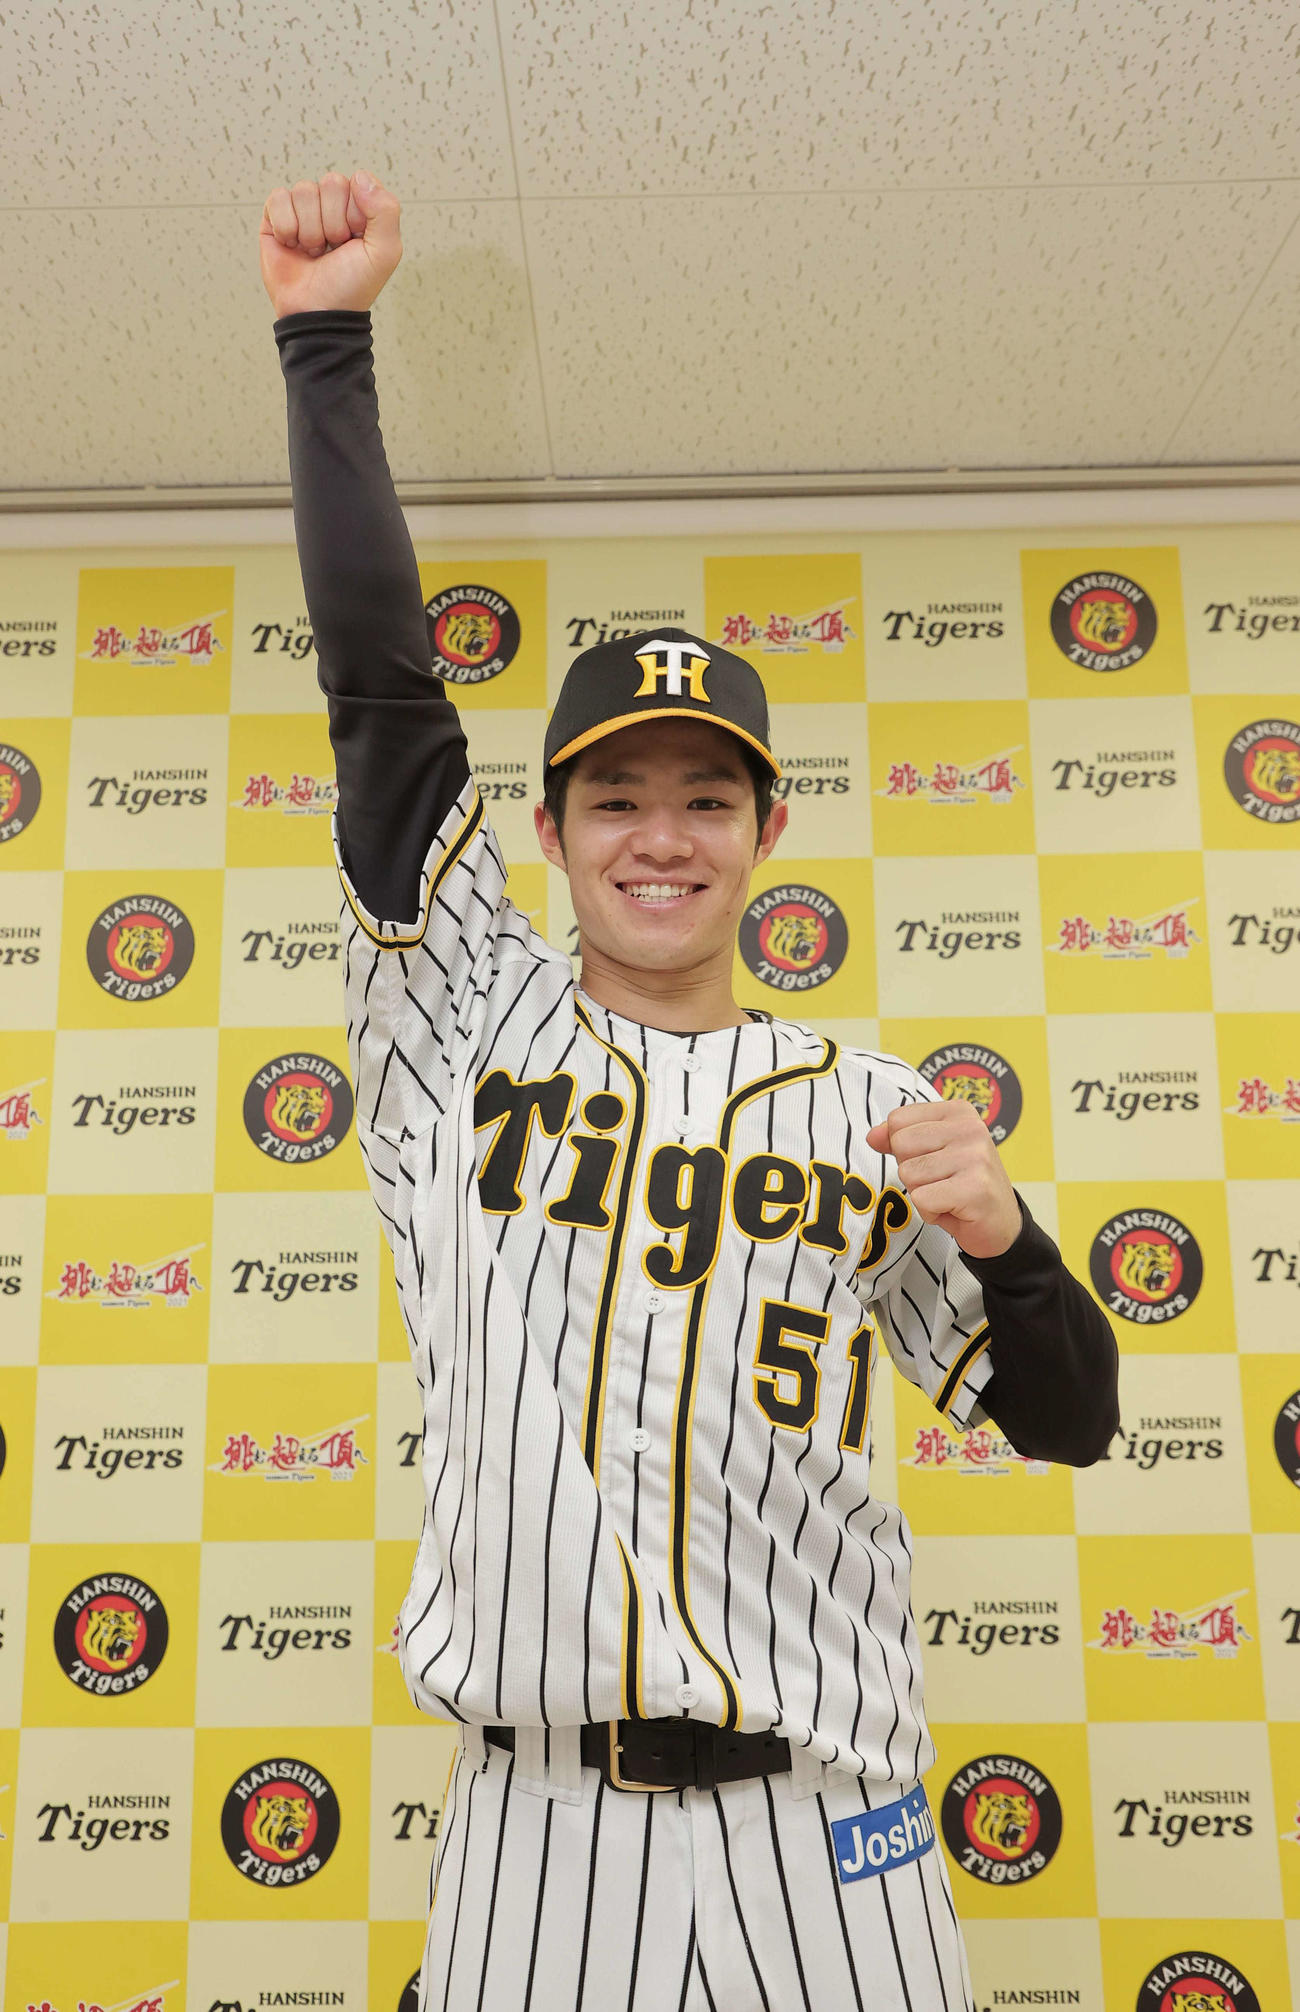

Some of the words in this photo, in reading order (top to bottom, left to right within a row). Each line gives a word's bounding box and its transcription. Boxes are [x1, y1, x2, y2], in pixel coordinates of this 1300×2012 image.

[426, 588, 509, 618] HANSHIN
[1061, 574, 1143, 606] HANSHIN
[611, 609, 685, 621] HANSHIN
[928, 602, 1003, 614] HANSHIN
[1204, 603, 1300, 640] Tiger
[0, 621, 57, 632] NSHIN
[252, 623, 314, 660] Tig
[883, 610, 1004, 647] Tigers
[0, 639, 57, 657] ers
[1069, 643, 1143, 671] Tigers
[432, 656, 504, 683] Tigers
[474, 763, 527, 775] NSHIN
[1097, 750, 1175, 762] HANSHIN
[133, 769, 208, 781] HANSHIN
[477, 782, 527, 800] ers
[773, 776, 850, 800] gers
[1052, 760, 1177, 798] Tigers
[87, 776, 208, 814] Tigers
[1243, 793, 1300, 822] Tige
[100, 898, 183, 930] HANSHIN
[750, 888, 834, 920] HANSHIN
[942, 911, 1020, 923] HANSHIN
[288, 923, 341, 934] HANS
[896, 919, 1022, 959] Tigers
[1227, 914, 1300, 954] Tig
[242, 930, 342, 969] Tiger
[102, 971, 176, 1000] Tigers
[756, 960, 833, 991] Tigers
[256, 1056, 342, 1090] HANSHIN
[920, 1047, 1008, 1080] HANSHIN
[1119, 1071, 1198, 1084] HANSHIN
[120, 1086, 196, 1098] HANSHIN
[1071, 1079, 1200, 1121] Tigers
[72, 1094, 196, 1135] Tigers
[260, 1130, 336, 1163] Tigers
[473, 1068, 912, 1290] Tigers
[1100, 1212, 1188, 1248] HANSHIN
[280, 1252, 358, 1264] HANSHIN
[231, 1259, 358, 1302] Tigers
[1108, 1290, 1190, 1323] Tigers
[753, 1297, 875, 1454] 51
[103, 1427, 184, 1440] HANSHIN
[1141, 1417, 1222, 1430] HANSHIN
[54, 1435, 183, 1480] Tigers
[67, 1577, 156, 1613] HANSHIN
[974, 1601, 1058, 1614] HANSHIN
[270, 1606, 352, 1618] HANSHIN
[220, 1615, 352, 1660] Tigers
[924, 1609, 1060, 1656] Tigers
[69, 1660, 149, 1693] Tigers
[234, 1762, 327, 1800] HANSHIN
[951, 1758, 1048, 1797] HANSHIN
[88, 1796, 170, 1808] HANSHIN
[1165, 1791, 1251, 1804] HANSHIN
[37, 1803, 170, 1851] Tigers
[841, 1799, 934, 1874] Joshin
[1115, 1798, 1253, 1847] Tigers
[238, 1849, 321, 1885] Tigers
[961, 1848, 1046, 1883] Tigers
[1147, 1957, 1246, 1996] HANSHIN
[259, 1992, 344, 2006] HANSHIN
[993, 1990, 1080, 2005] HANSHIN
